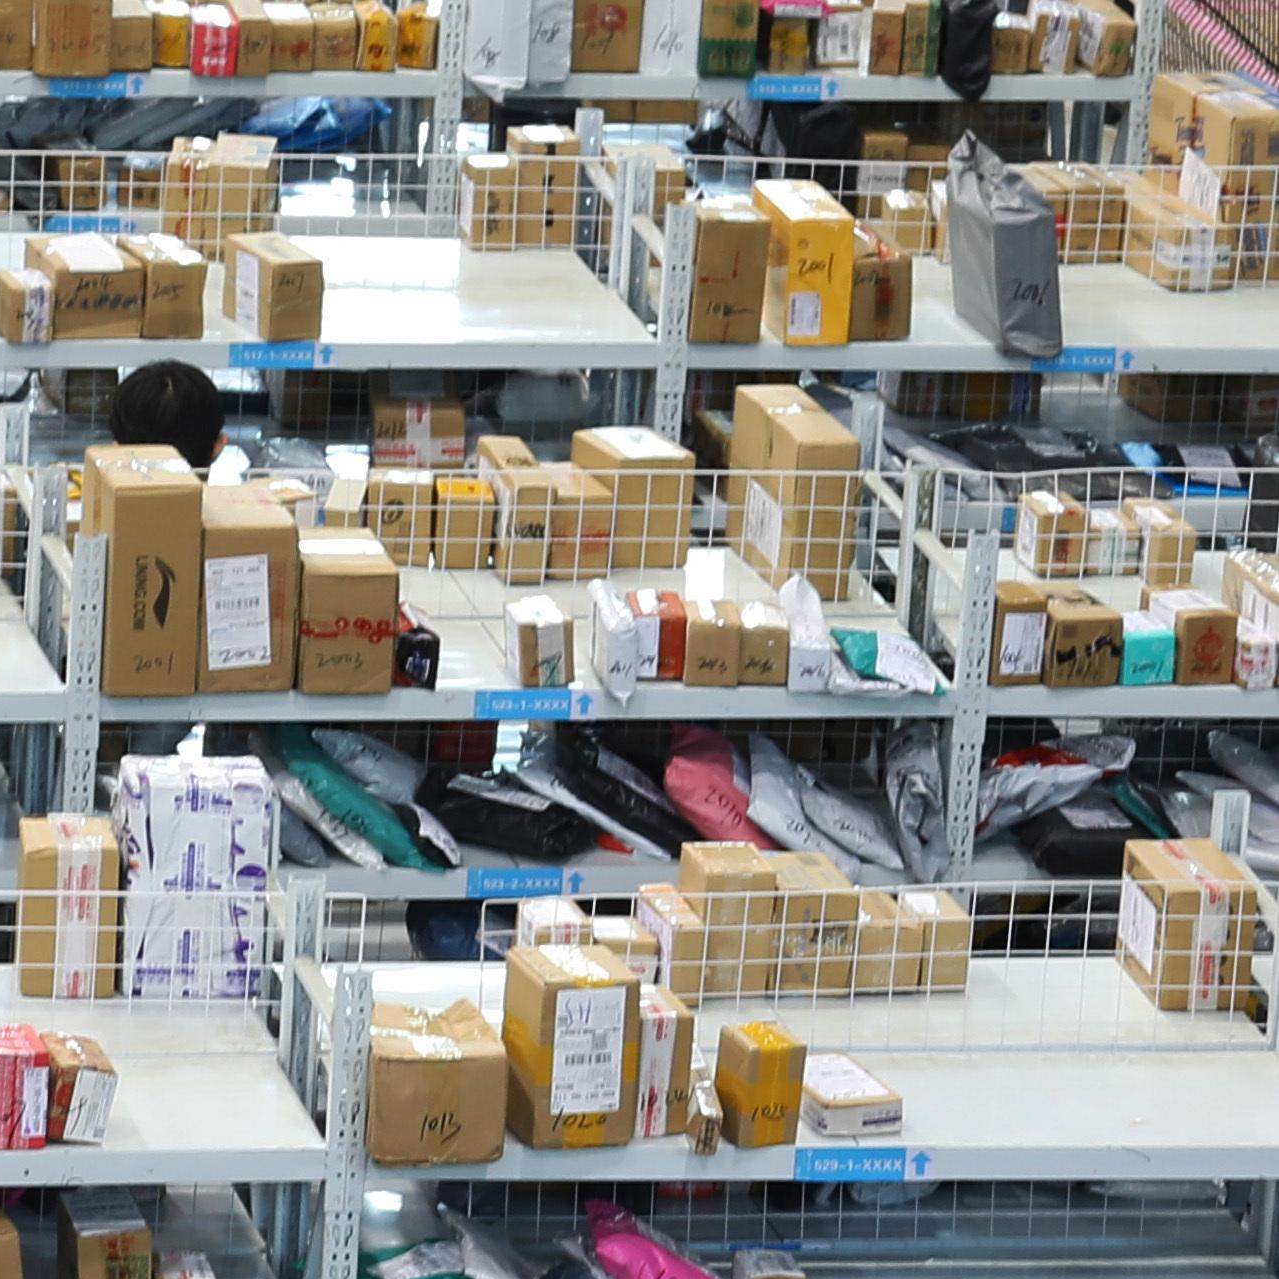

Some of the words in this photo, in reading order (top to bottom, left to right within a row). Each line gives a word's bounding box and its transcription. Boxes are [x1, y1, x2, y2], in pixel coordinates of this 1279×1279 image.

[798, 254, 835, 283] 2001
[133, 651, 175, 676] 2001
[491, 698, 568, 712] 523-1-XXXX
[482, 877, 561, 889] 523-2-XXXX
[813, 1158, 902, 1172] 529-1-XXXX
